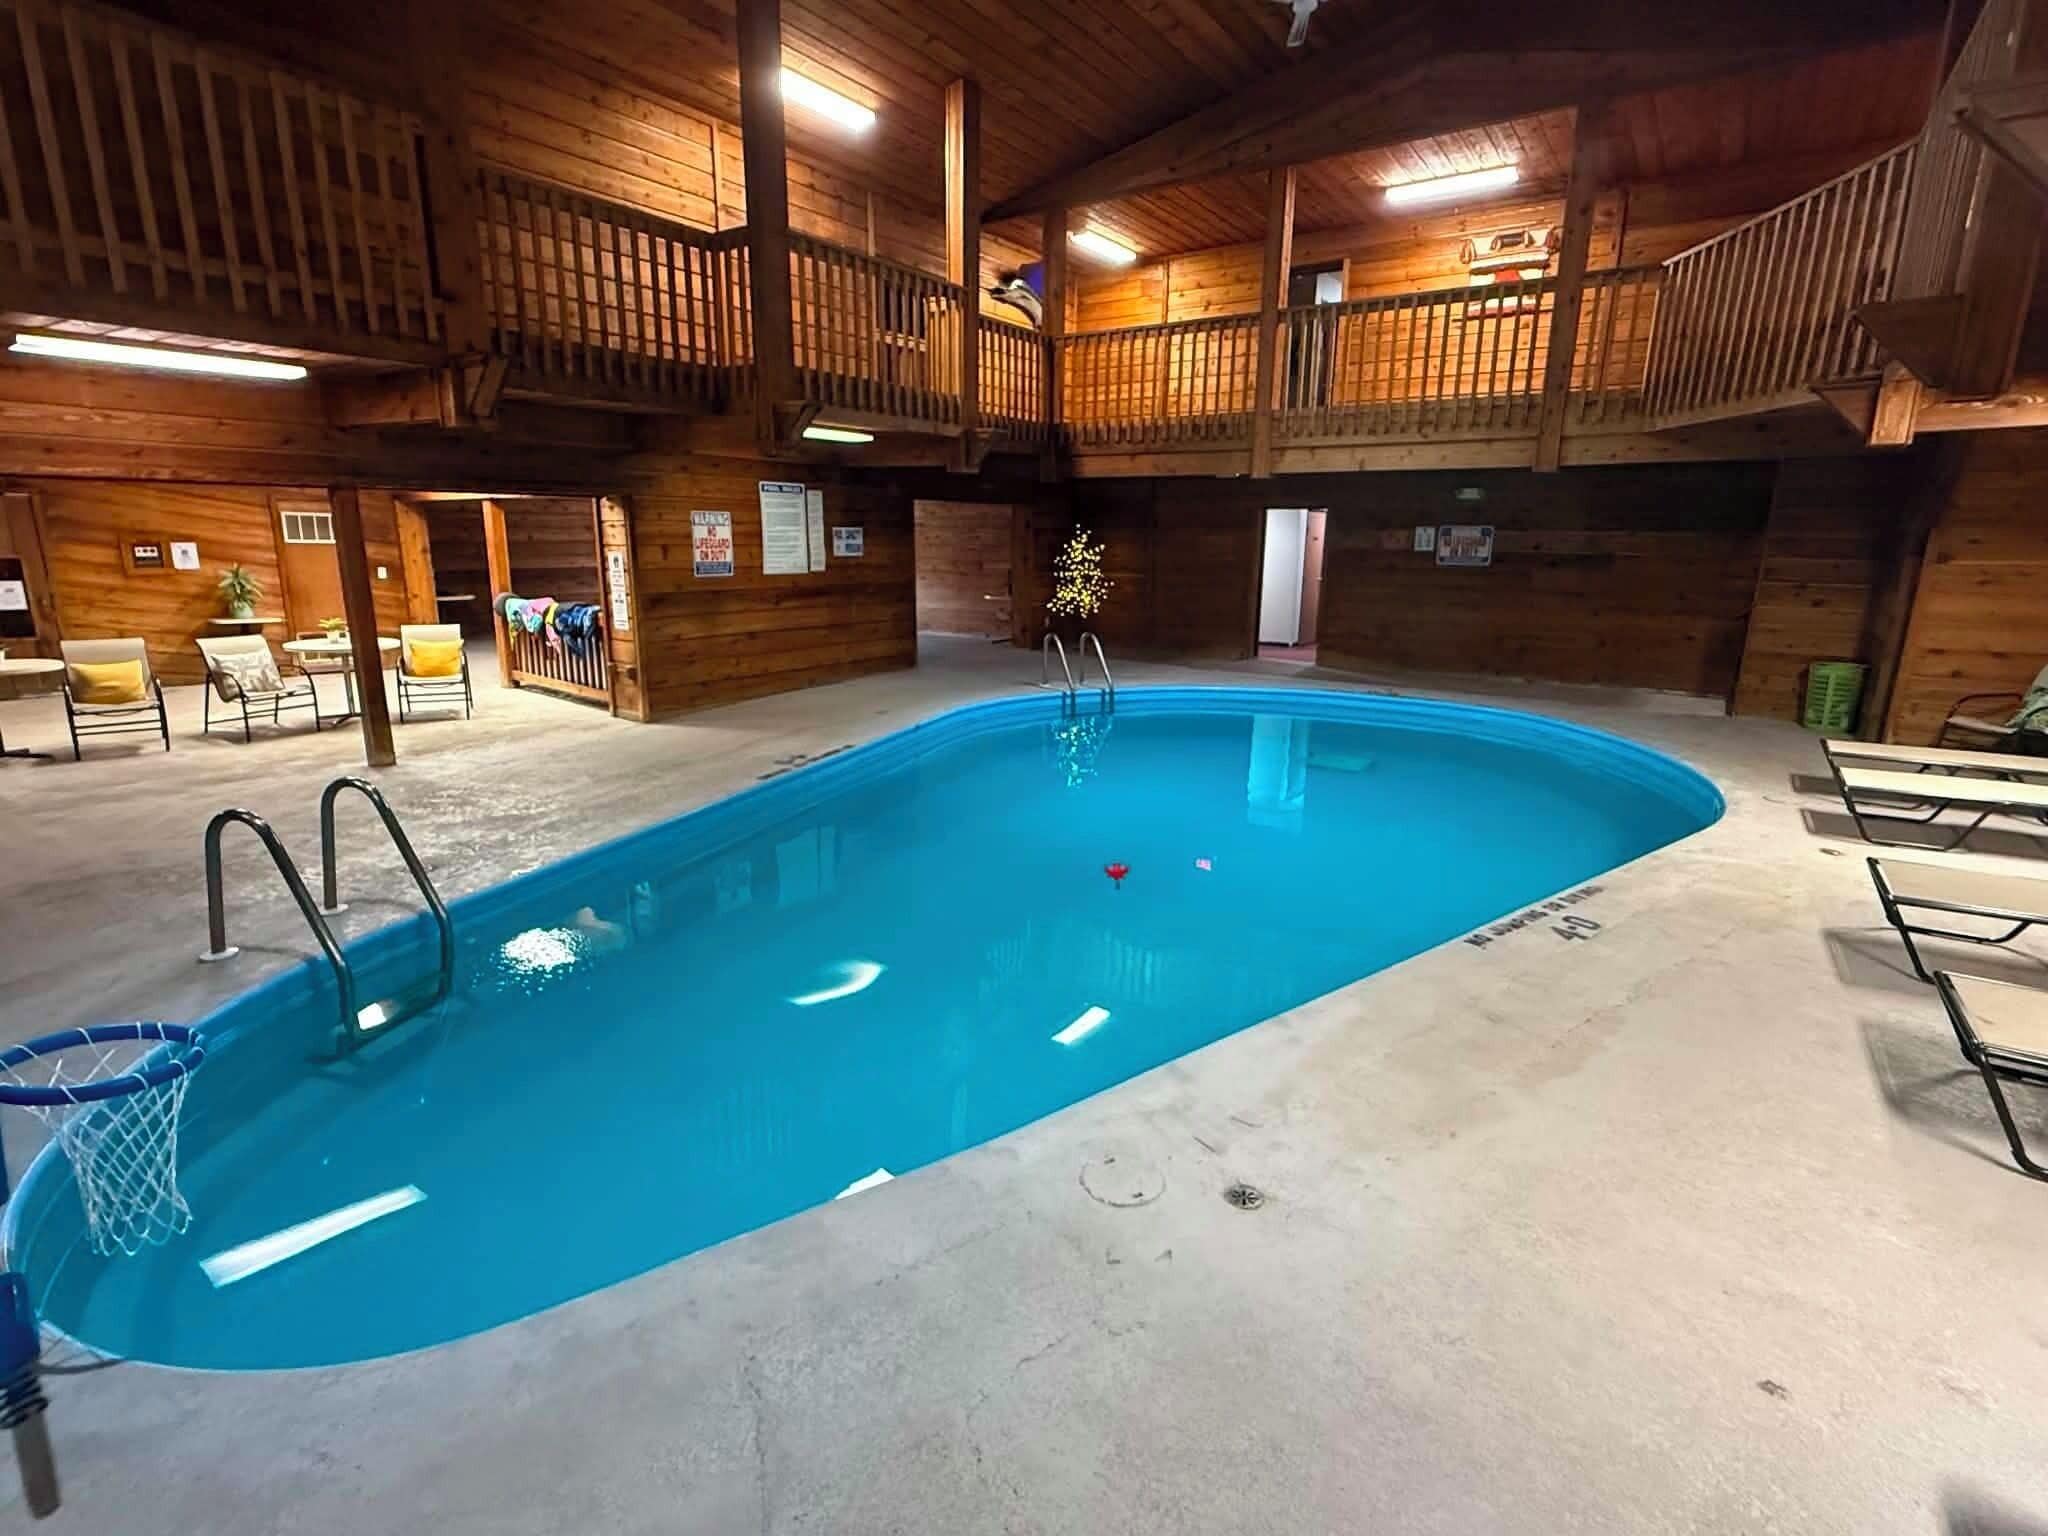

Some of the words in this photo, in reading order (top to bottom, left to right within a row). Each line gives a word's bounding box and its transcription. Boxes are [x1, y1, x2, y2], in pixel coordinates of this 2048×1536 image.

[695, 537, 730, 549] LIFEGUARD
[700, 550, 709, 560] ON
[711, 550, 727, 560] DUTY
